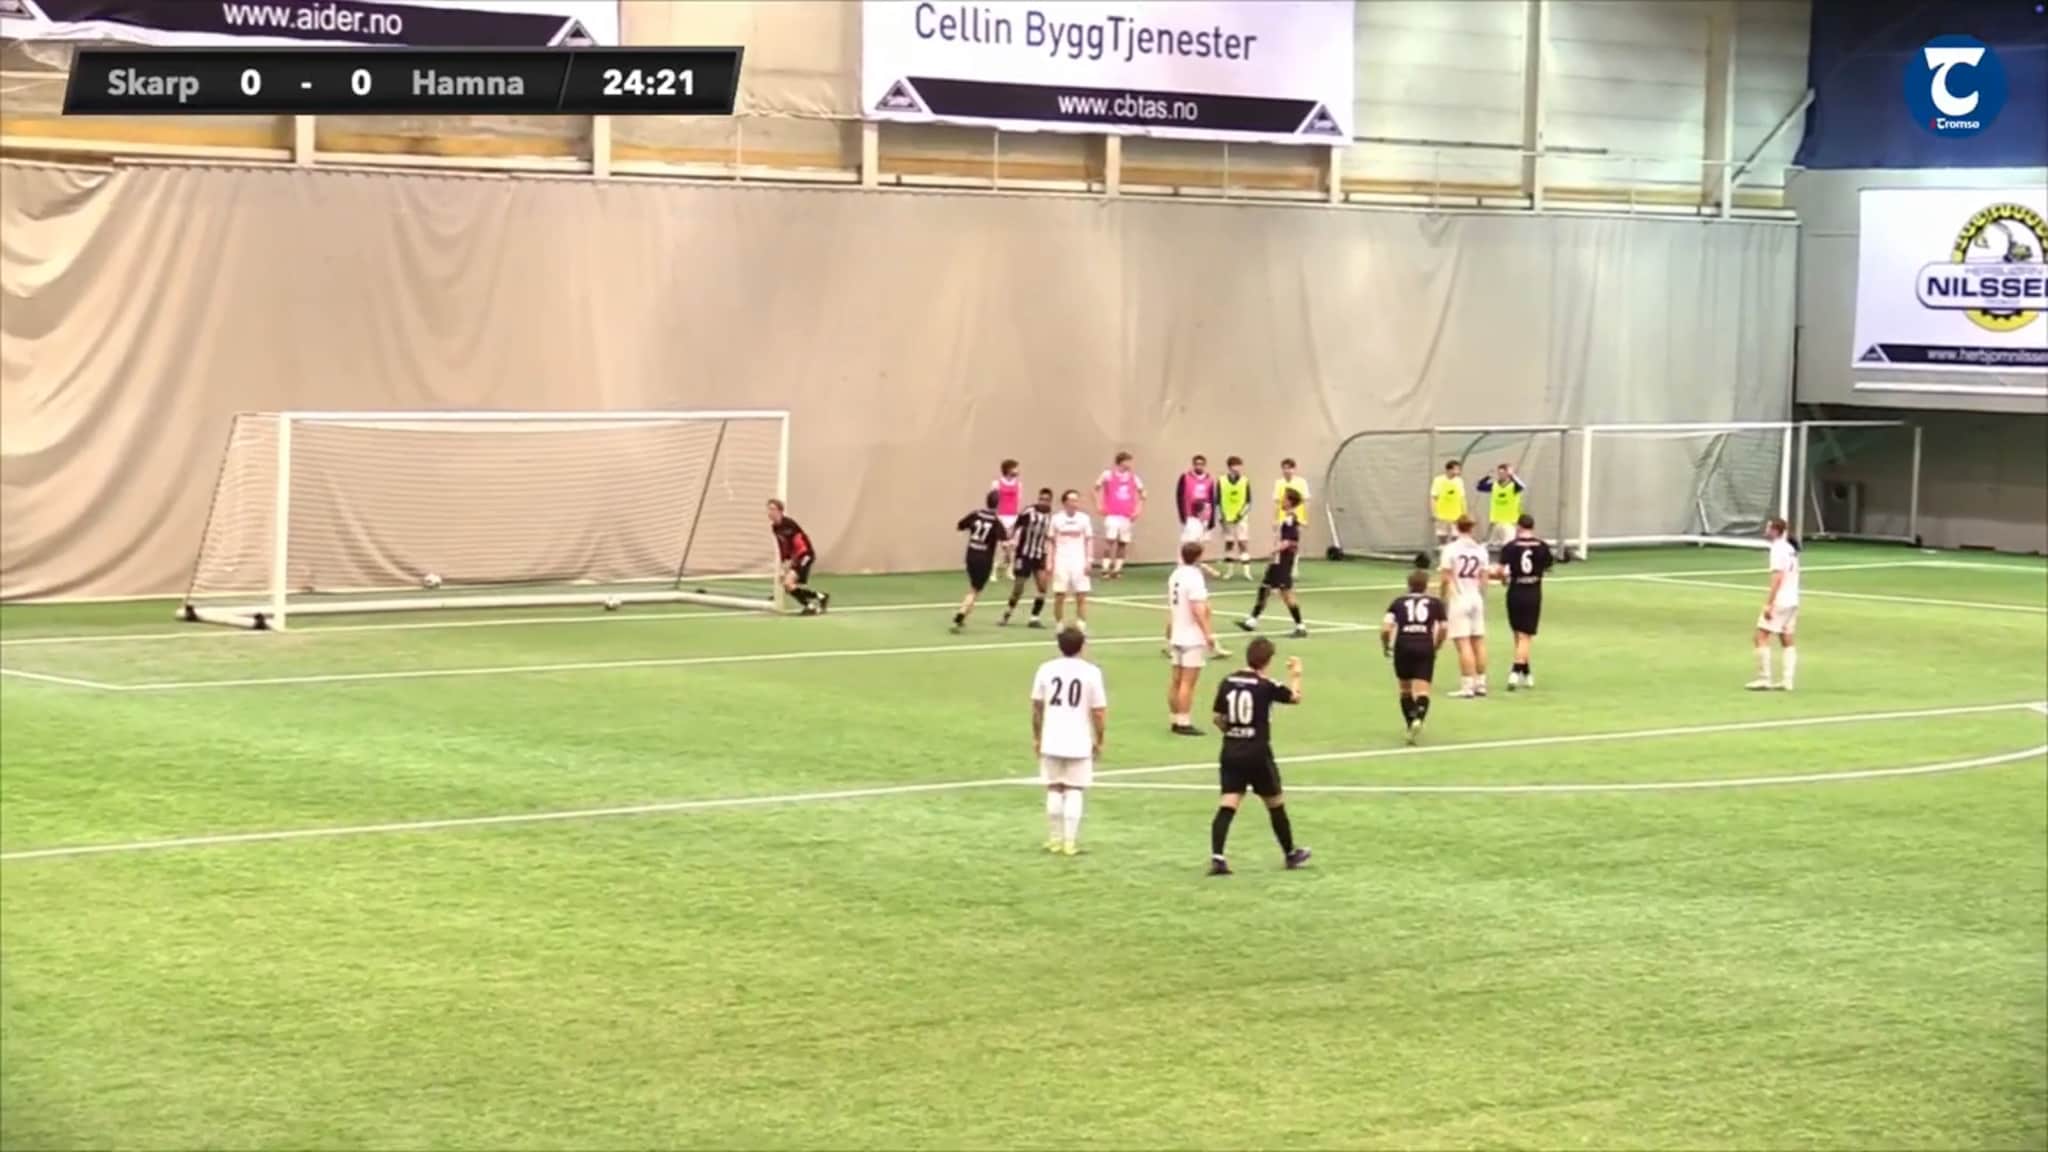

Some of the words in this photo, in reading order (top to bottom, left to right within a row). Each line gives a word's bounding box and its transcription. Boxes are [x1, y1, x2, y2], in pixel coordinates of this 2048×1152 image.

[223, 1, 402, 36] www.aider.no
[915, 2, 1012, 44] Cellin
[1025, 11, 1257, 62] ByggTjenester
[1058, 94, 1198, 121] www.cbtas.no
[1927, 276, 2048, 298] NILSSE
[1458, 554, 1479, 578] 22
[1521, 549, 1533, 574] 6
[1405, 600, 1429, 622] 16
[1049, 676, 1082, 708] 20
[1226, 689, 1253, 725] 10
